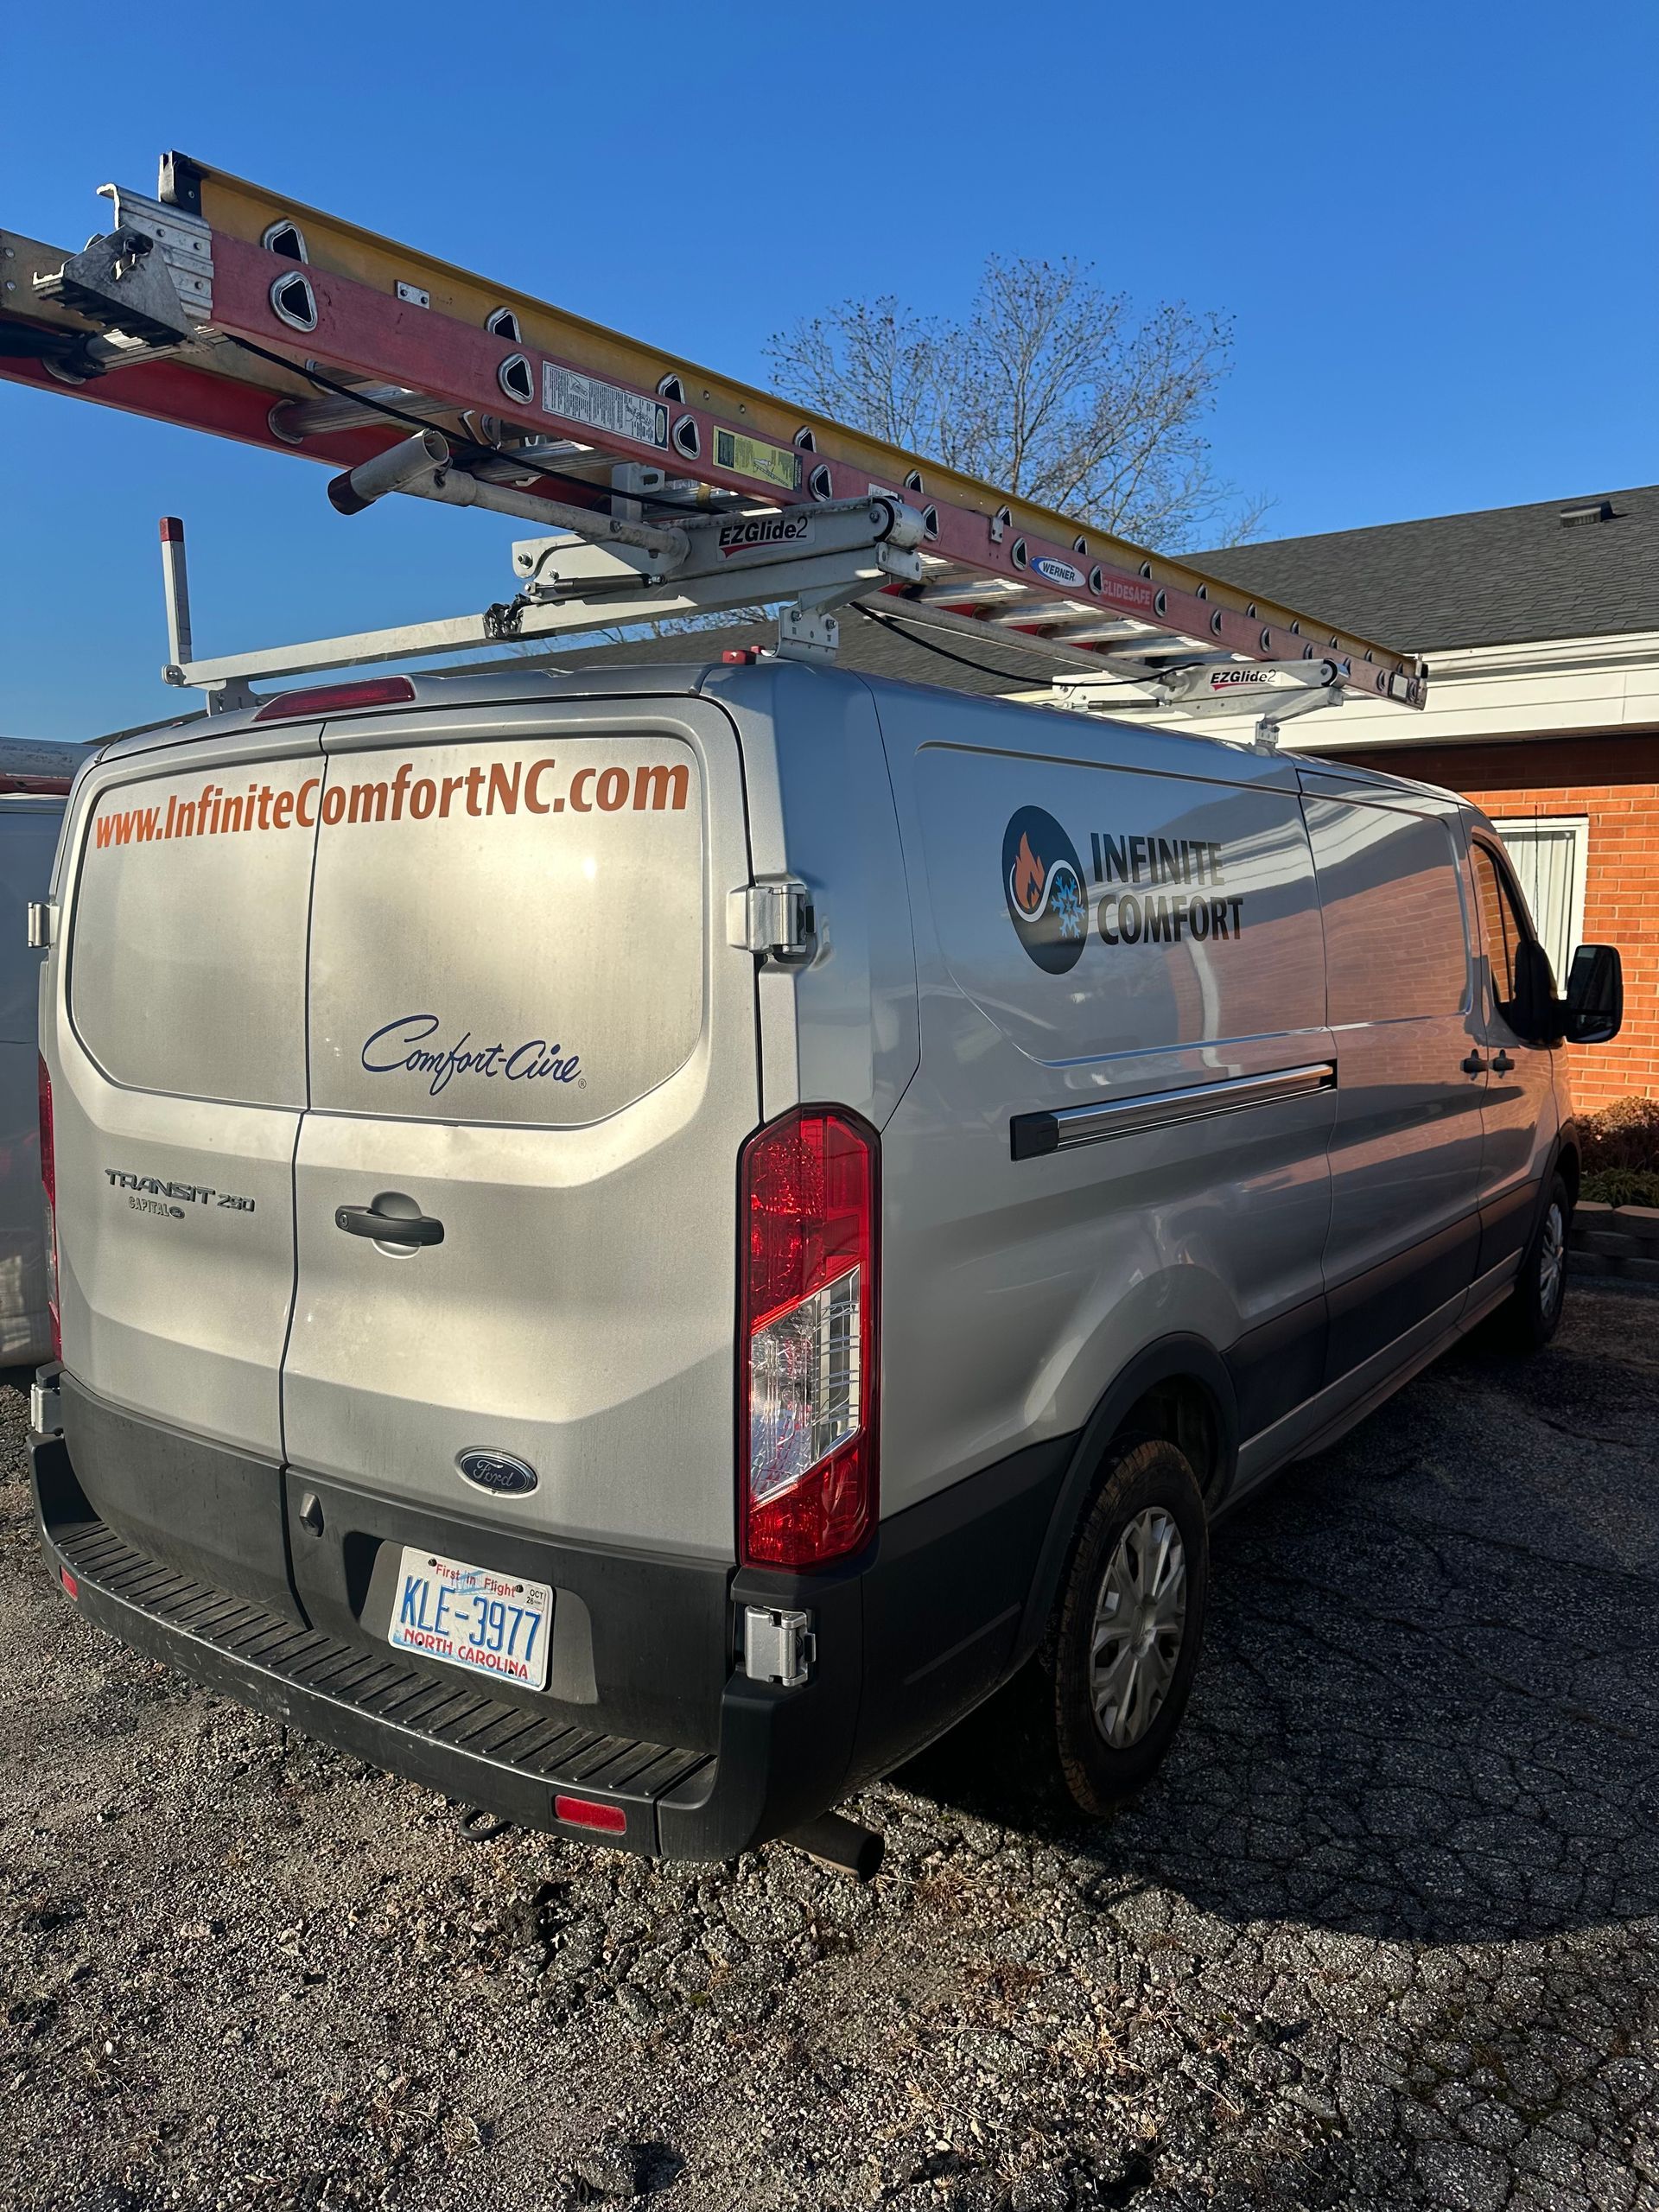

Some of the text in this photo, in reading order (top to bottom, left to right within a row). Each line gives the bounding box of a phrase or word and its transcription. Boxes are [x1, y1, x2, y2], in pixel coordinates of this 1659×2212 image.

[718, 516, 808, 547] EZGlide2
[1042, 562, 1076, 582] WERNER
[1102, 578, 1151, 605] GLIDESAFE
[1210, 669, 1276, 684] EZGlide2
[96, 759, 690, 849] www.InfiniteComfortNC.com
[1090, 832, 1225, 886] INFINITE
[1096, 893, 1244, 946] COMFORT
[105, 1168, 216, 1205] TRANSIT
[129, 1196, 170, 1217] CAPITAL
[473, 1459, 514, 1486] Ford
[435, 1563, 517, 1598] First in Flight
[529, 1588, 544, 1599] OCT
[400, 1574, 543, 1662] KLE-3977
[404, 1628, 529, 1680] NORTH CAROLINA
